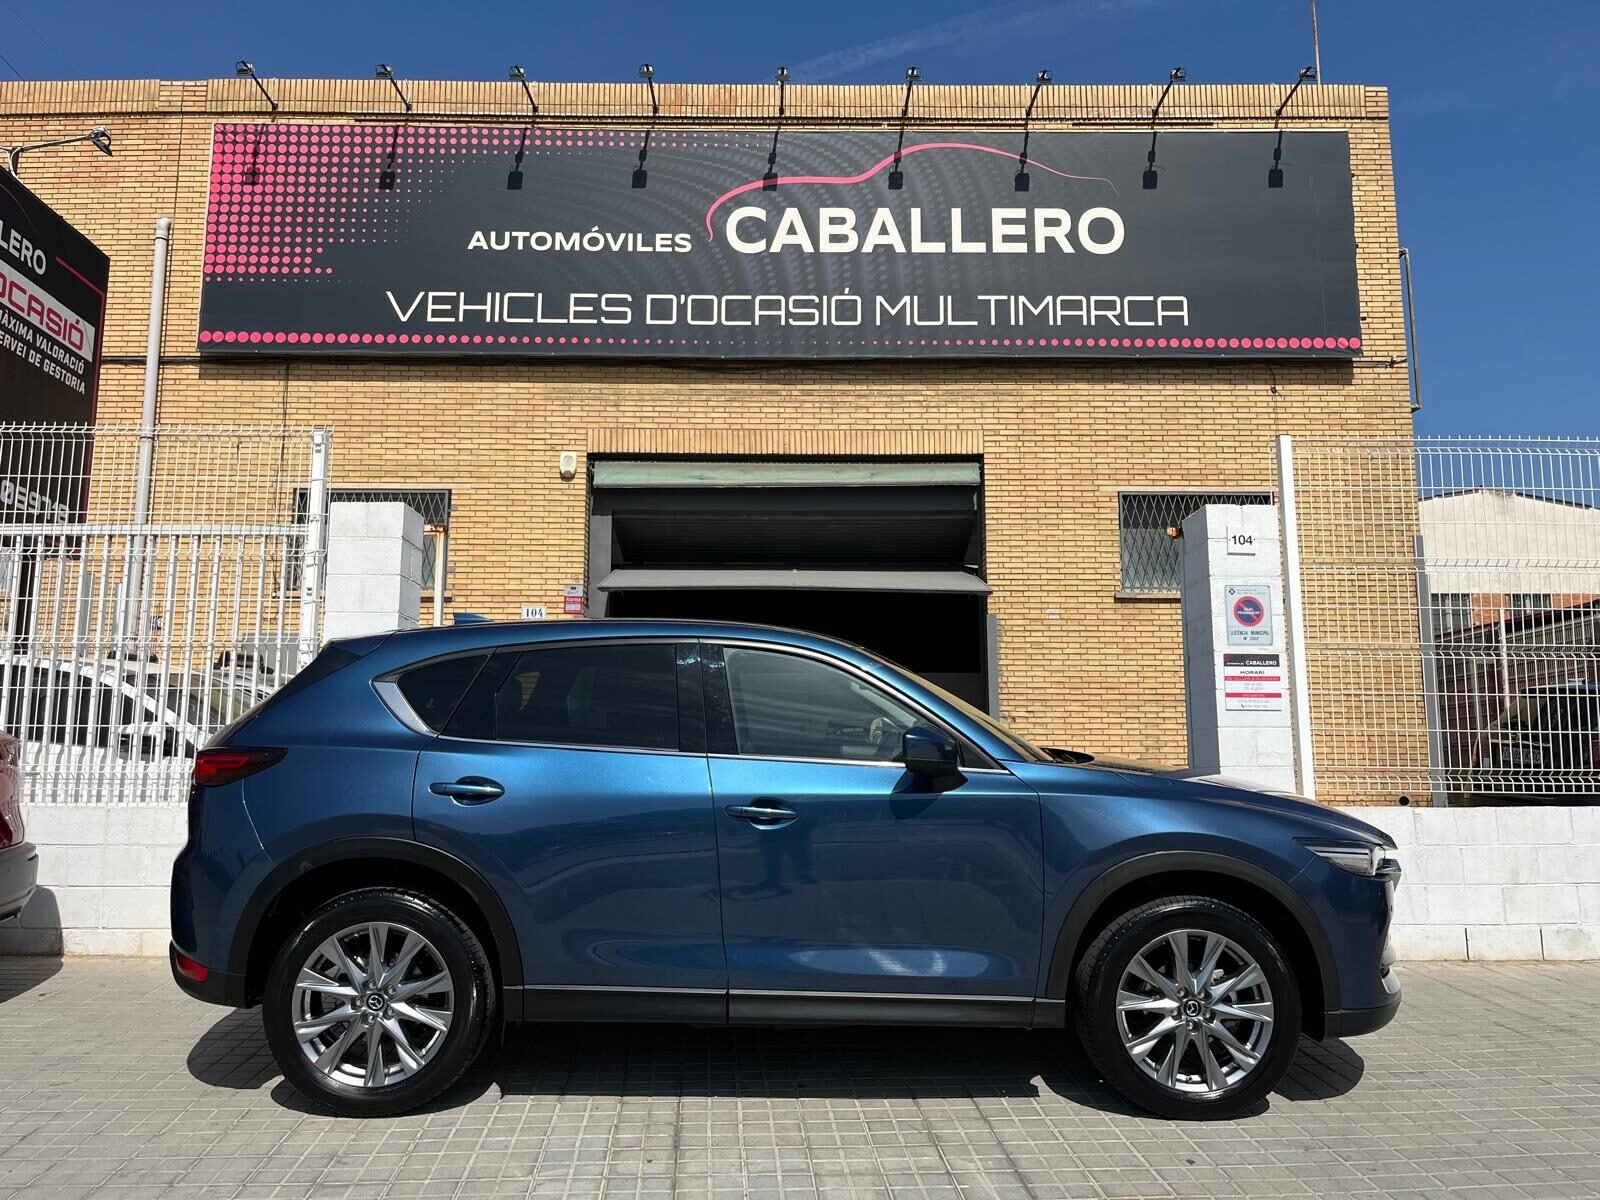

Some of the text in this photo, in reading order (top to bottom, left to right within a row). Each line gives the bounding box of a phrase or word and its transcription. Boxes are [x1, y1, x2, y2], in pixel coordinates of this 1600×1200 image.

[467, 206, 1126, 255] AUTOMÓVILES CABALLERO
[386, 287, 1189, 327] VEHICLES D'OCASIÓ MULTIMARCA
[29, 349, 42, 367] DE
[43, 359, 86, 395] GESTORIA
[36, 333, 85, 375] VALORACIÓ
[1231, 534, 1253, 546] 104
[526, 608, 543, 618] 104
